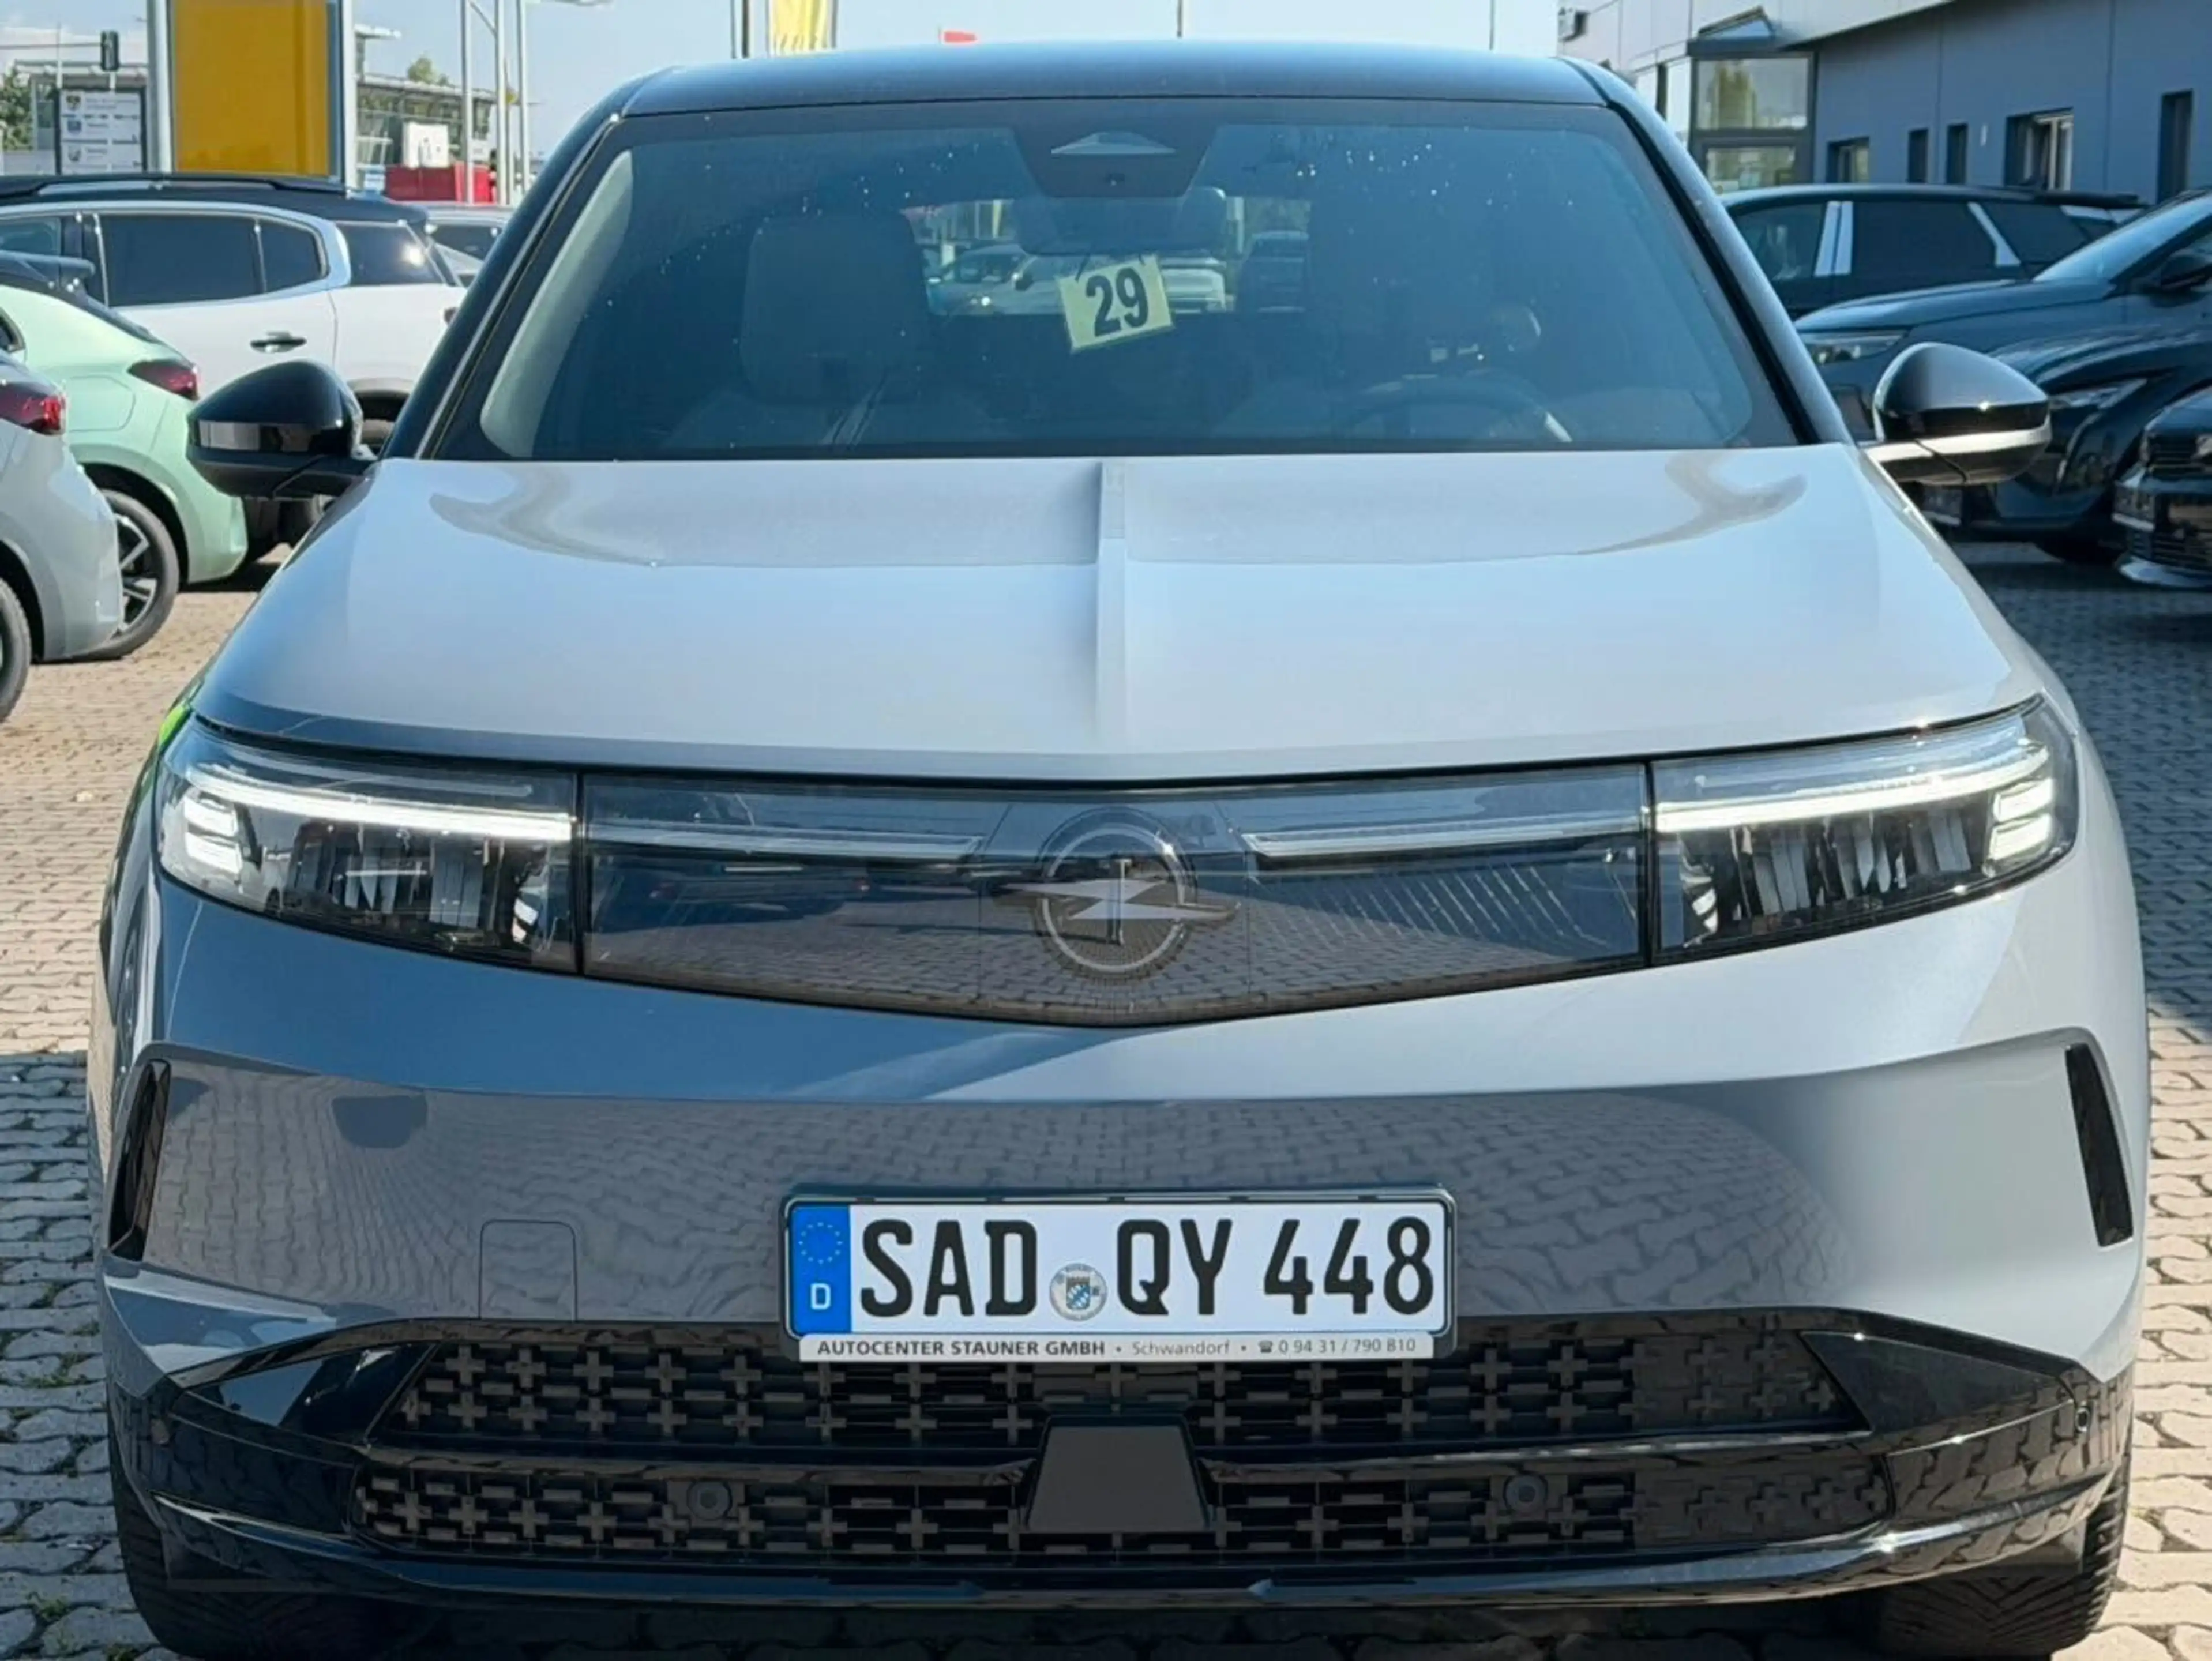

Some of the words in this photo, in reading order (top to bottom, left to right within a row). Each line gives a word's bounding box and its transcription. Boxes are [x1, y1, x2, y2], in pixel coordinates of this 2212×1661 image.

[1086, 267, 1148, 337] 29
[861, 1219, 1037, 1317] SAD
[1117, 1218, 1233, 1315] QY
[1264, 1216, 1433, 1315] 448
[810, 1283, 831, 1310] D
[817, 1340, 944, 1355] AUTOCENTER
[951, 1340, 1039, 1355] STAUNER
[1045, 1340, 1105, 1355] GMBH
[1132, 1339, 1230, 1355] Schwandorf
